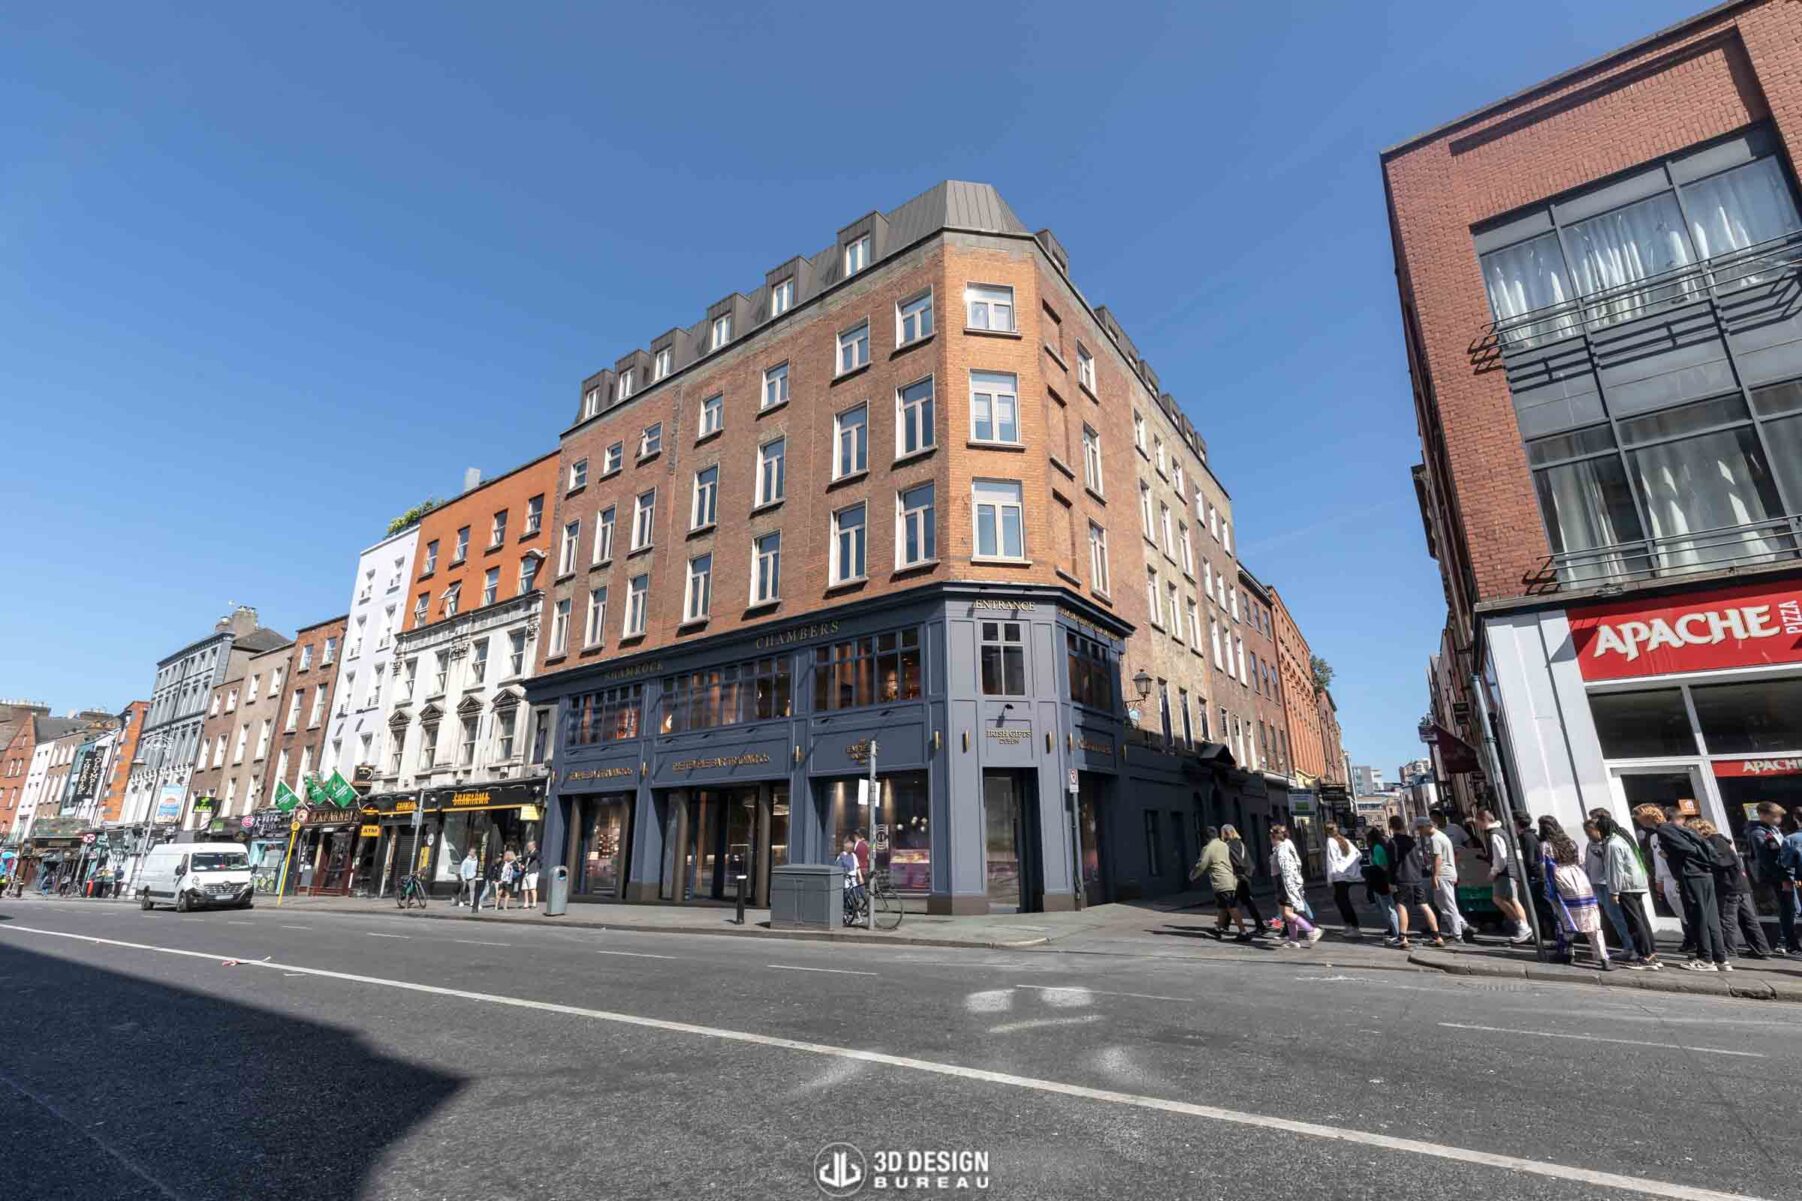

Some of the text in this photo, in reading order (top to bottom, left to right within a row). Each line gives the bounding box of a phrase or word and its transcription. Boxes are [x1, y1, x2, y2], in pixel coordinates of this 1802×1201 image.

[975, 600, 1036, 612] ENTRANCE
[1779, 600, 1802, 635] PIZZA
[755, 620, 840, 649] CHAMBERS
[1593, 604, 1781, 662] APACHE
[986, 729, 1008, 738] IRISH
